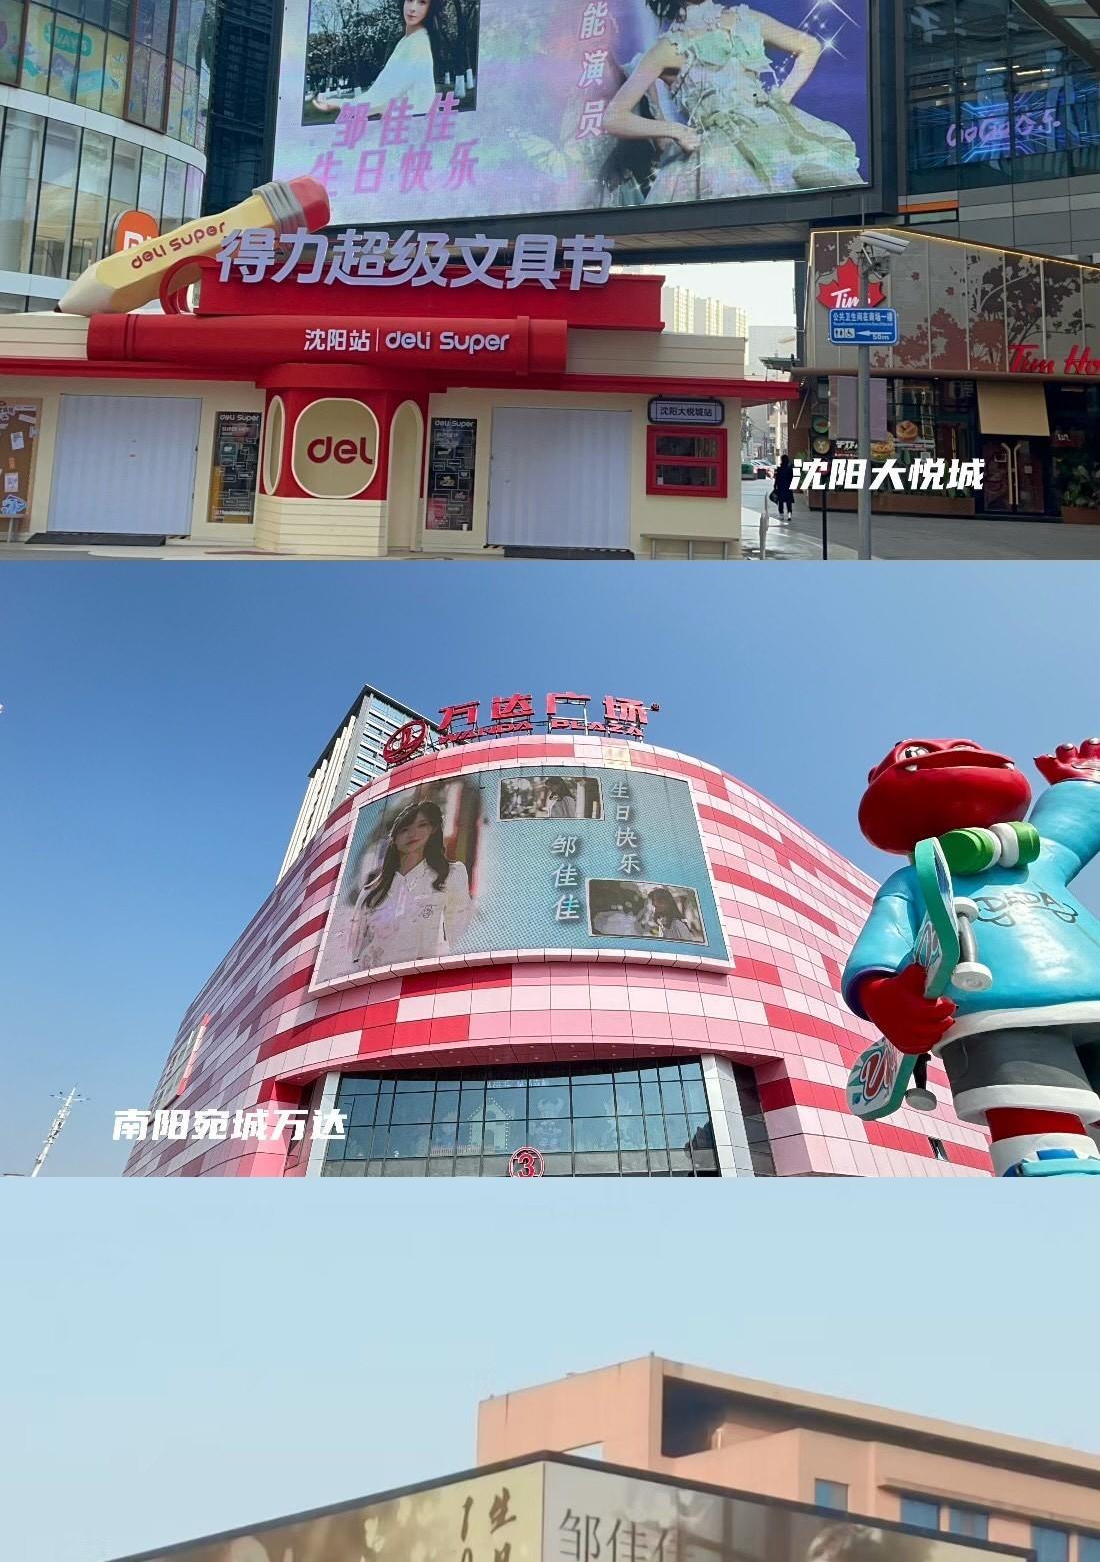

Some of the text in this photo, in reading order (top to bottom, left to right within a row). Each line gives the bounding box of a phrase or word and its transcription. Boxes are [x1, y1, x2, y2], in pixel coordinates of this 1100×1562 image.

[332, 90, 461, 150] 邹佳佳
[311, 137, 481, 197] 生日快乐
[130, 243, 167, 271] deli
[169, 220, 227, 251] Super
[215, 227, 615, 292] 得力超级文具节
[303, 327, 510, 355] 沈阳站 deli Super
[872, 333, 891, 341] 50m
[1008, 344, 1055, 375] Tim
[237, 414, 260, 423] Super
[451, 420, 475, 428] Super
[658, 406, 713, 419] 沈阳大悦城站
[437, 691, 649, 731] 万达广场
[438, 719, 645, 745] WANDA PLAZA
[609, 781, 641, 874] 生日快乐
[551, 835, 580, 922] 邹佳佳
